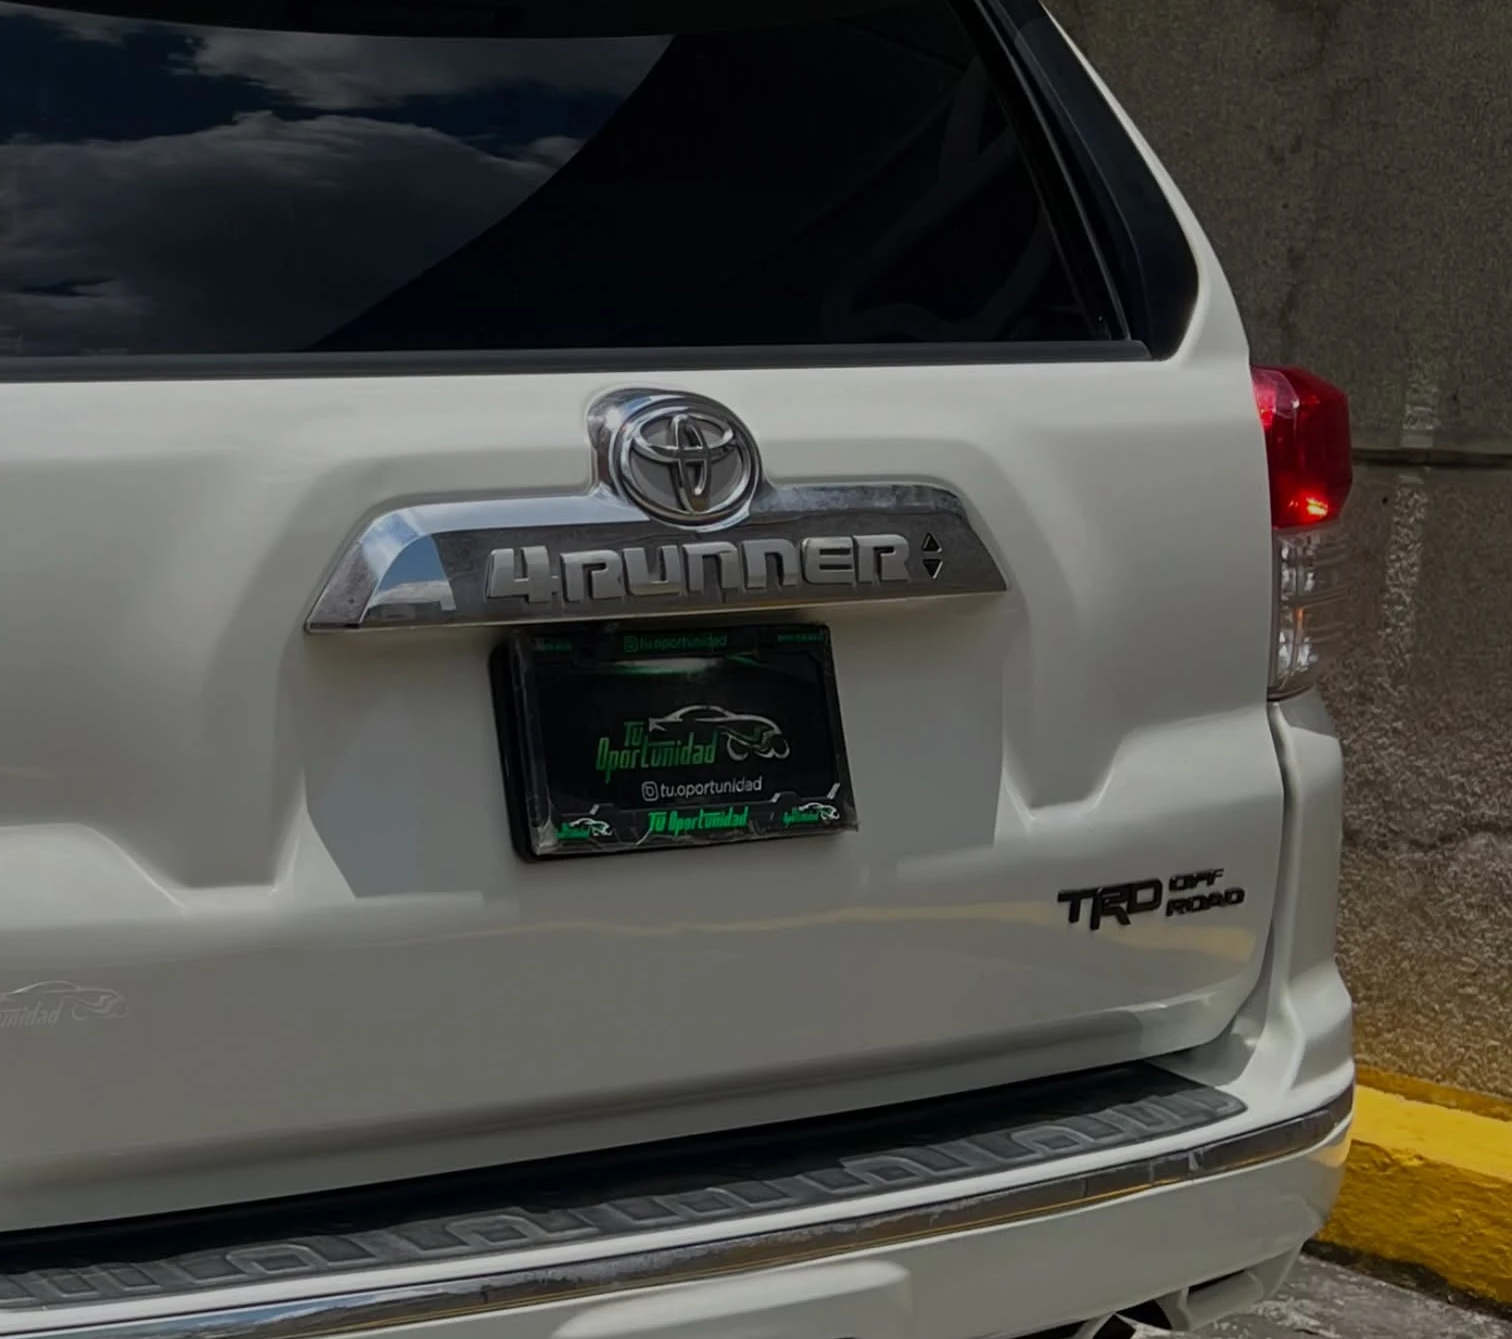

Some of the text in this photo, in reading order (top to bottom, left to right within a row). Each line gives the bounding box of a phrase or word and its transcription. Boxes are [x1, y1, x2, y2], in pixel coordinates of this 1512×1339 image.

[659, 776, 763, 800] tu.oportunidad
[1057, 877, 1164, 931] TRD
[1165, 886, 1246, 917] ROAD
